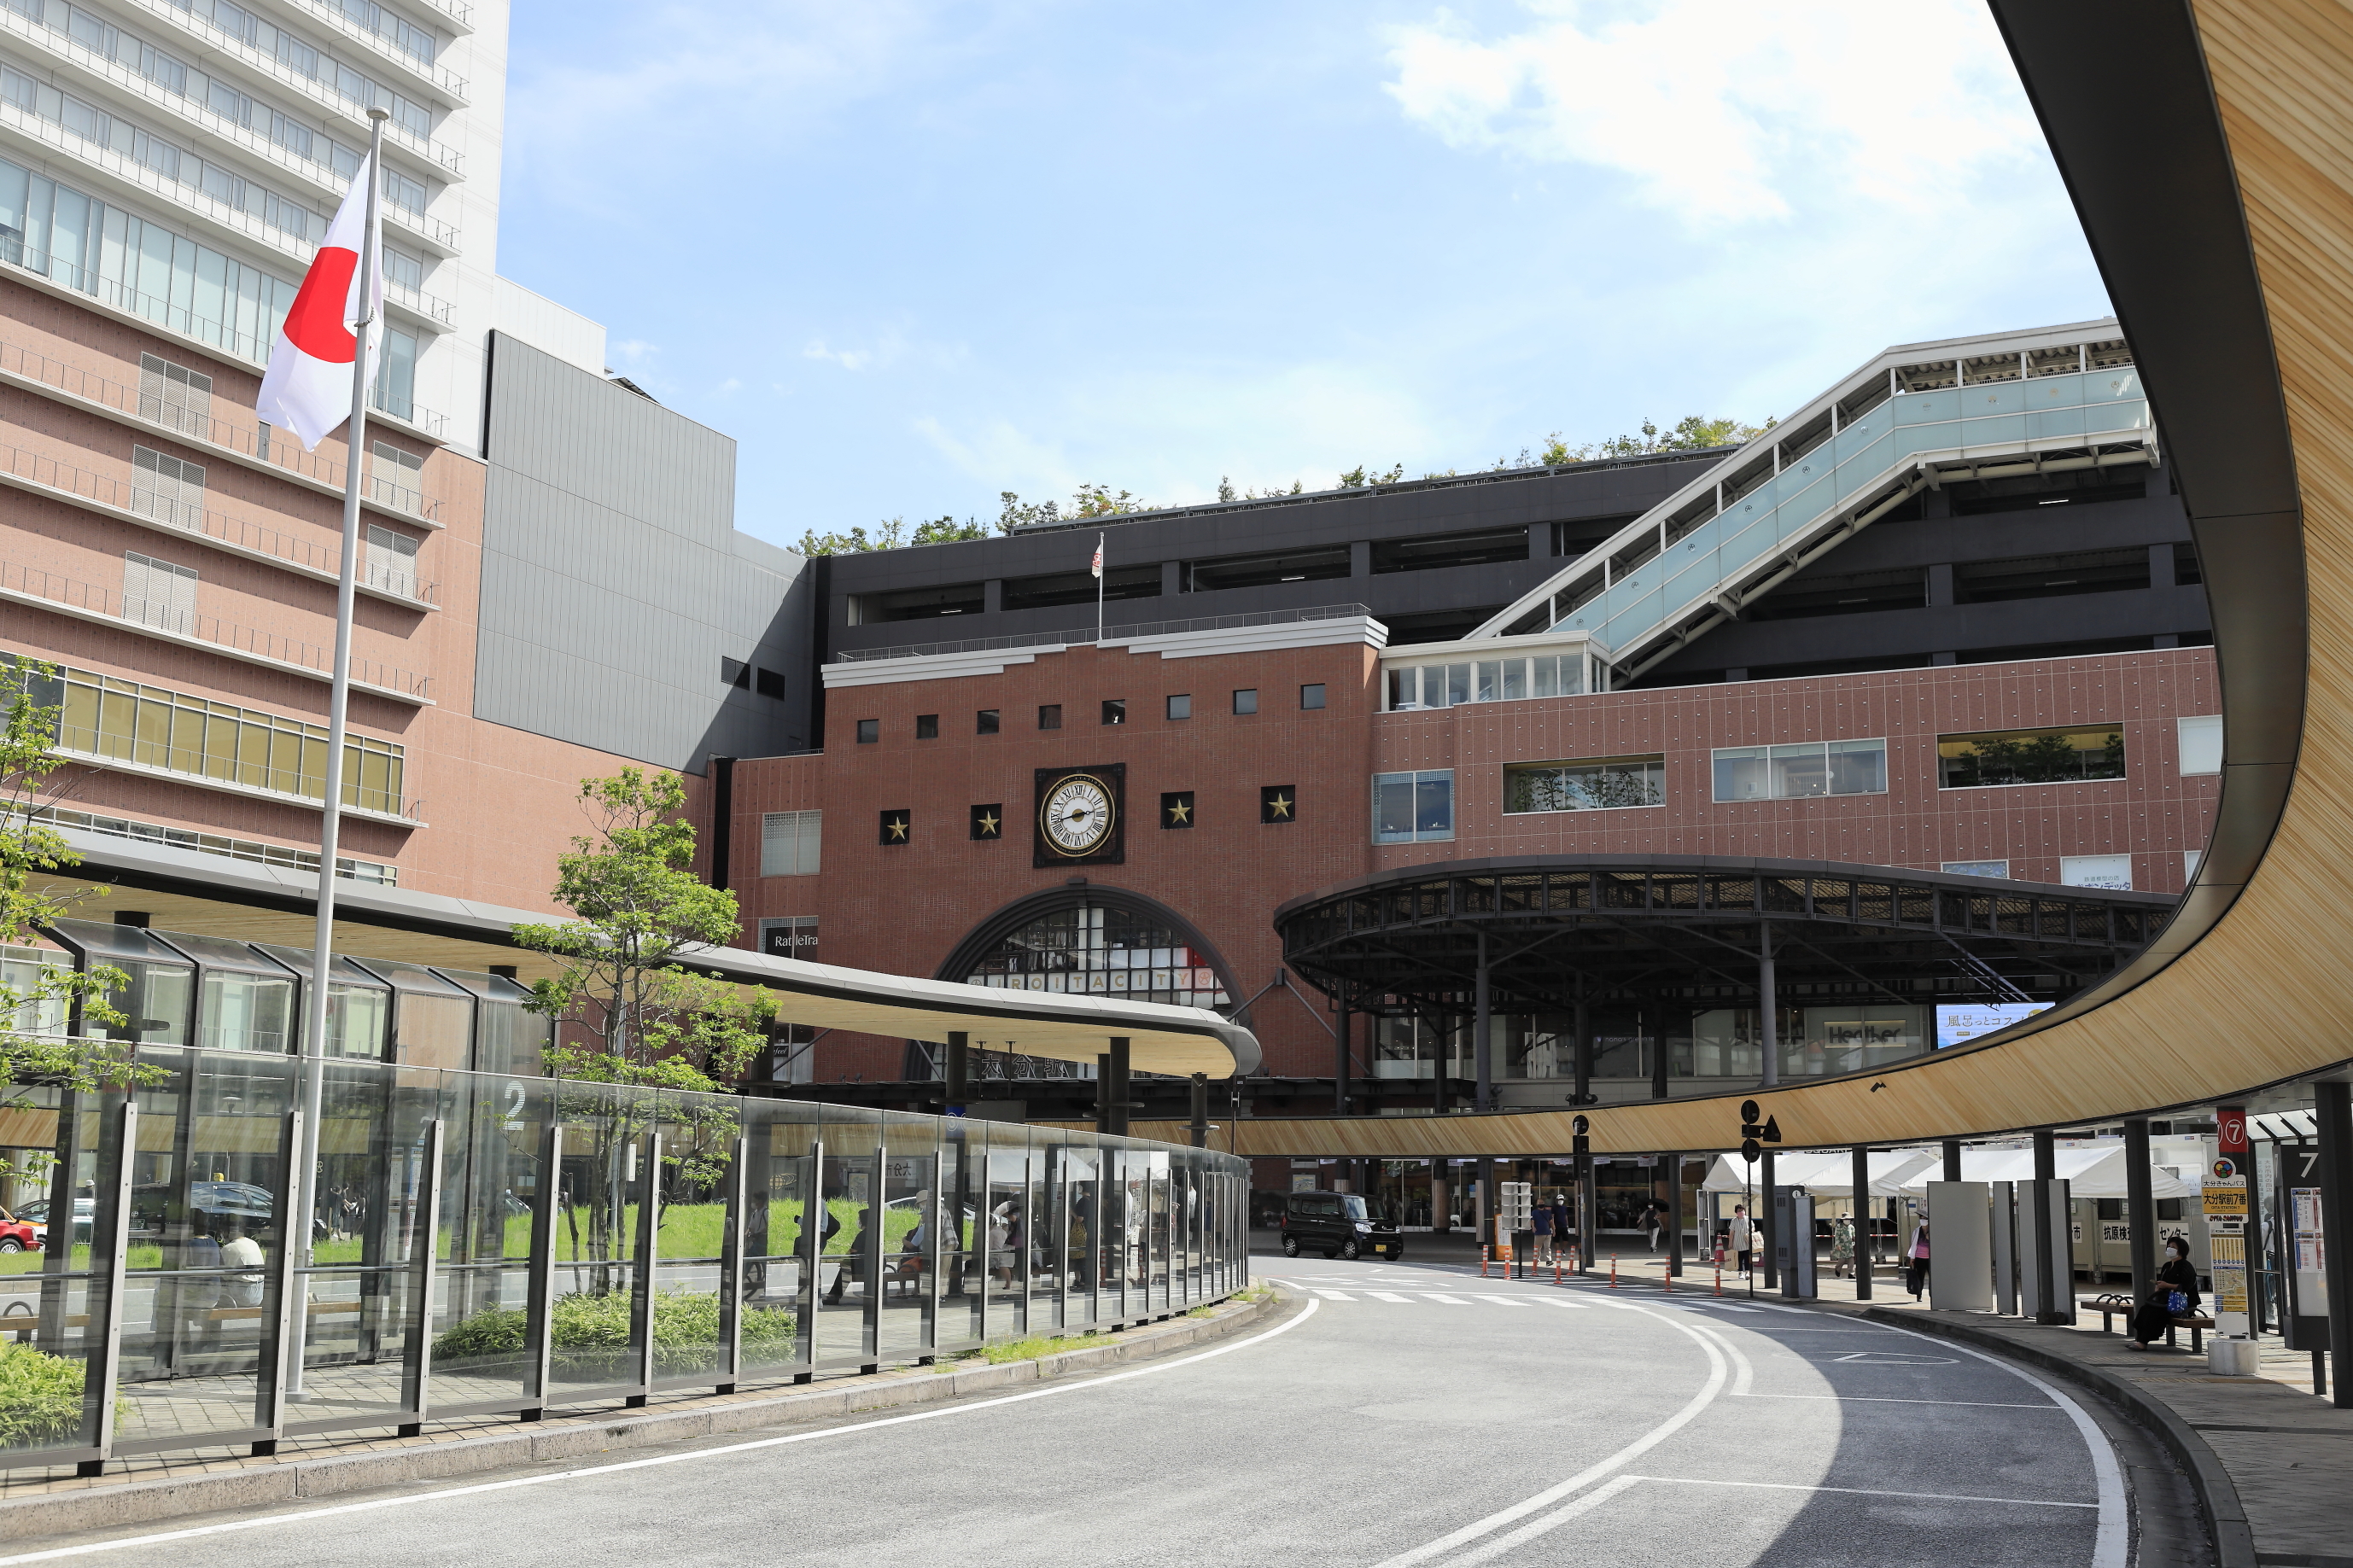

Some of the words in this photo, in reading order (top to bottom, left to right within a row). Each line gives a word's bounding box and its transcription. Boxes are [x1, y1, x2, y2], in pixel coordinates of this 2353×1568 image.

[1074, 785, 1083, 796] XII
[775, 935, 818, 947] RatleTra
[982, 1054, 1066, 1075] 大分駅
[504, 1080, 526, 1131] 2
[2299, 1152, 2319, 1179] 7
[2204, 1192, 2247, 1205] 大分駅前7番
[2159, 1227, 2189, 1240] センター
